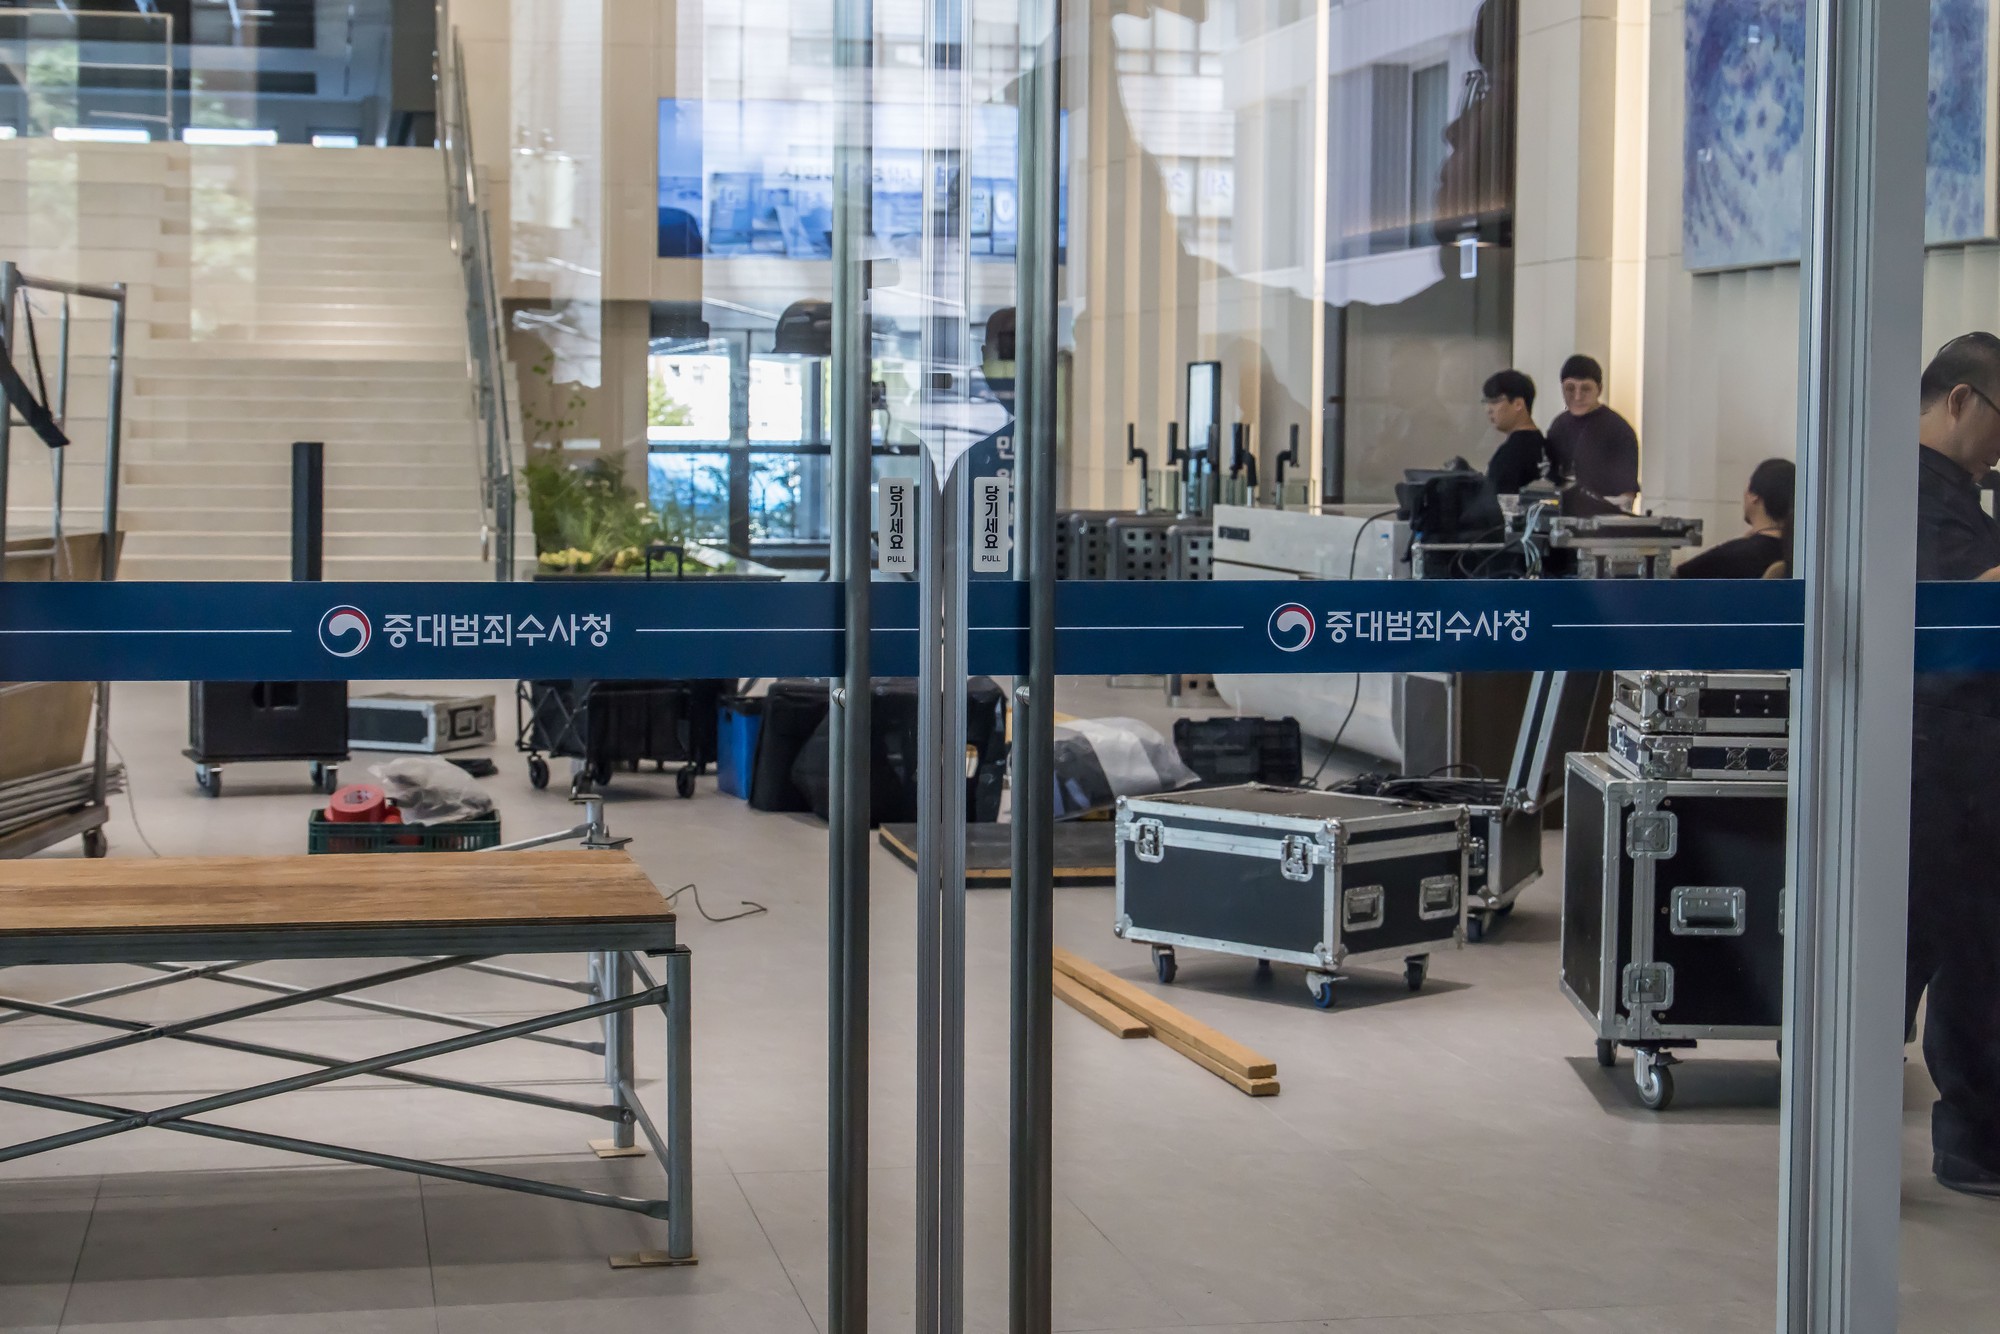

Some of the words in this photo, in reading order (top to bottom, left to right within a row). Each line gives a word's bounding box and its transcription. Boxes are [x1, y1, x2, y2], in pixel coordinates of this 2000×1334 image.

[889, 485, 905, 550] 당기세요
[984, 485, 1000, 549] 당기세요
[887, 555, 907, 563] PULL
[981, 554, 1001, 562] PULL
[382, 613, 611, 649] 중대범죄수사청
[1324, 609, 1531, 644] 중대범죄수사청
